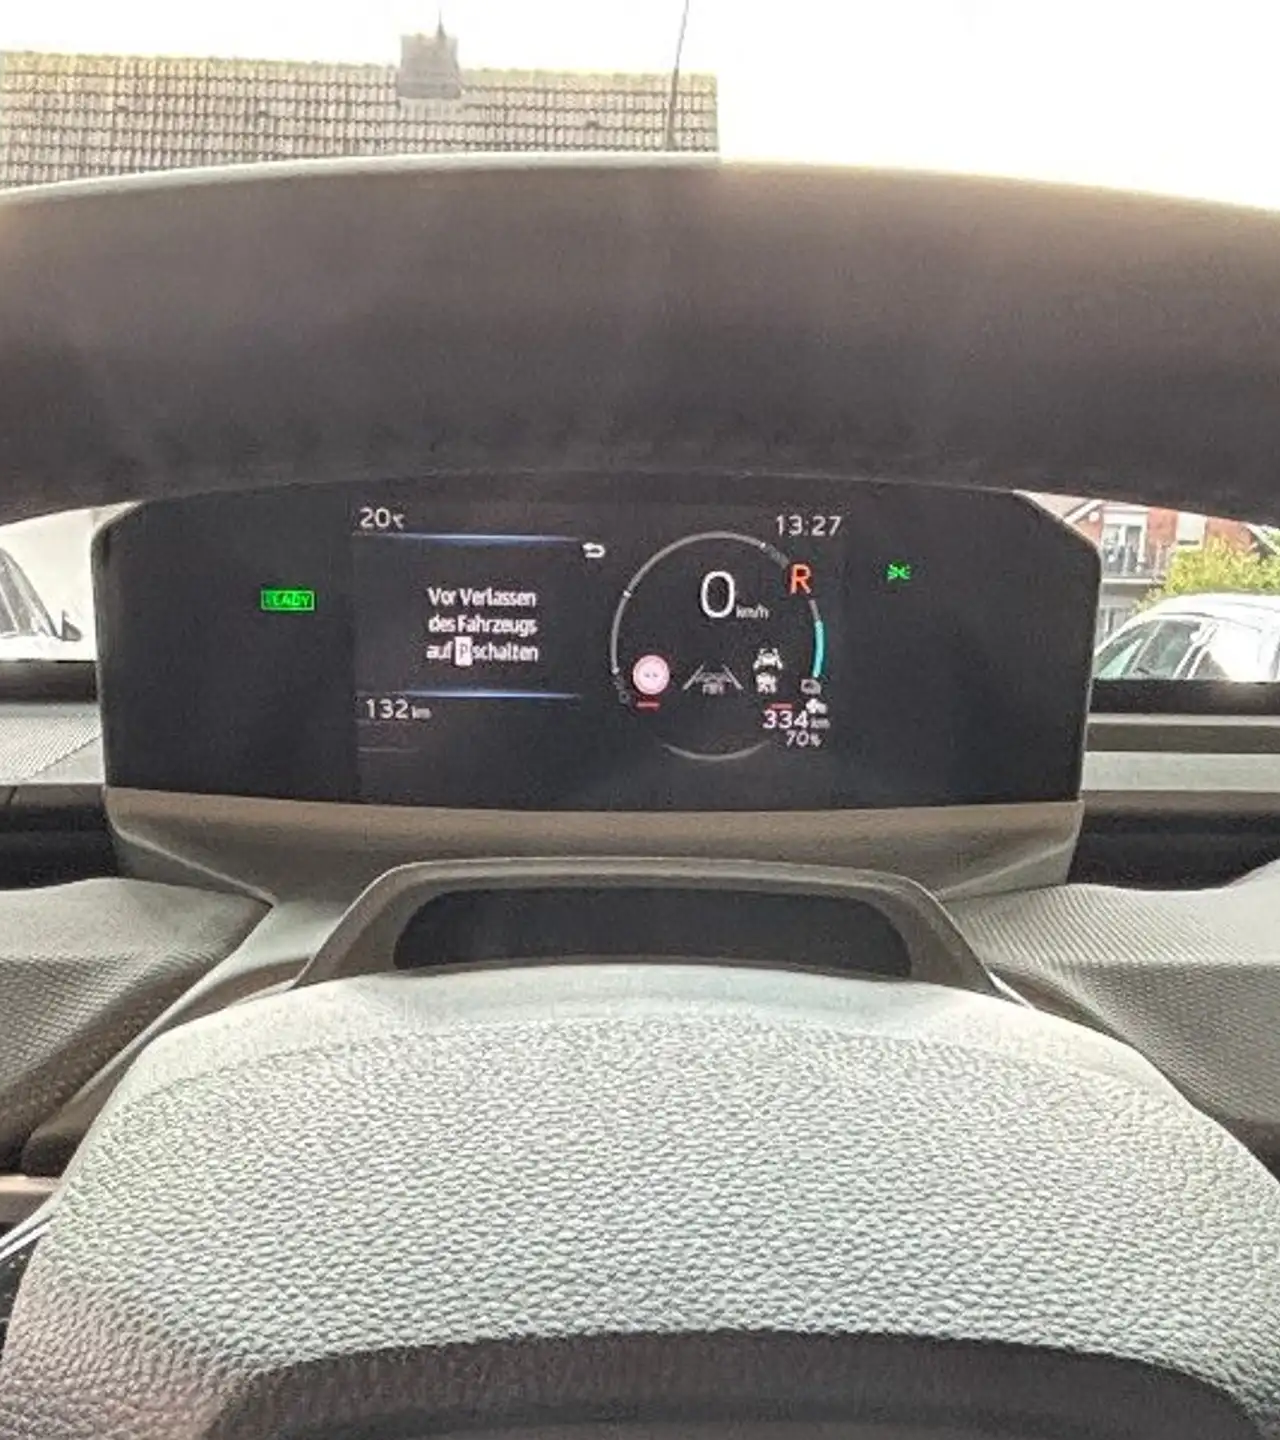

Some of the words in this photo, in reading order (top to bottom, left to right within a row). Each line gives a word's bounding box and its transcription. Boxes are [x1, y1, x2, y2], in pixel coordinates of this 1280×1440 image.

[776, 514, 842, 537] 13:27
[790, 563, 812, 595] R
[427, 587, 456, 606] Vor
[459, 586, 537, 608] Verlassen
[700, 571, 736, 619] 0
[427, 617, 456, 633] des
[458, 615, 538, 637] Fahrzeugs
[426, 641, 453, 661] auf
[472, 643, 540, 663] schalten
[366, 699, 409, 719] 132
[762, 710, 809, 729] 334
